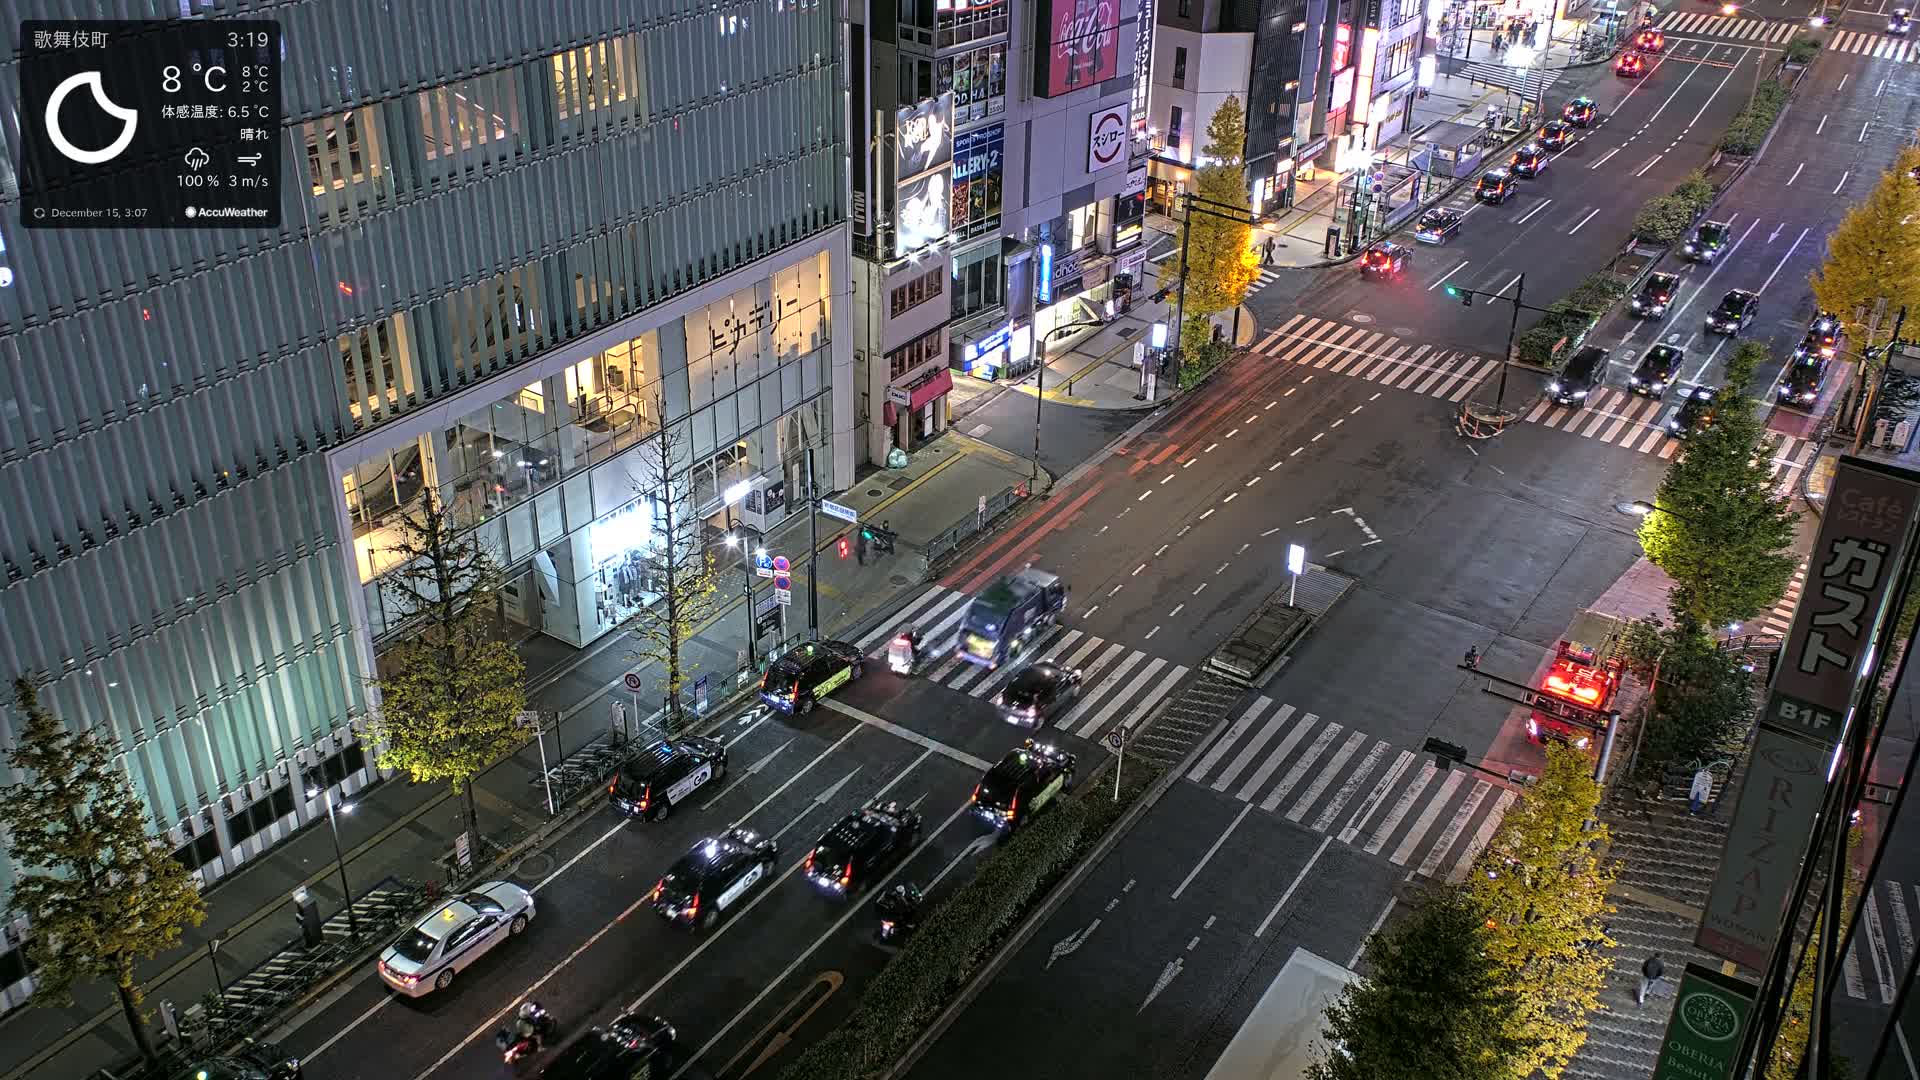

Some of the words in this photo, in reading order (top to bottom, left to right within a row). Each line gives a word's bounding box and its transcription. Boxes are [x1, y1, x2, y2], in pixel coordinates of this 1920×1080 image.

[1092, 129, 1125, 148] スシロー
[854, 190, 865, 225] MUJI
[711, 298, 798, 356] ピカデリー
[1799, 537, 1886, 673] ガスト
[1778, 700, 1832, 729] B1F
[1731, 776, 1793, 917] RIZAP
[1667, 1056, 1713, 1080] Beaut
[1668, 1041, 1726, 1072] OBERIA
